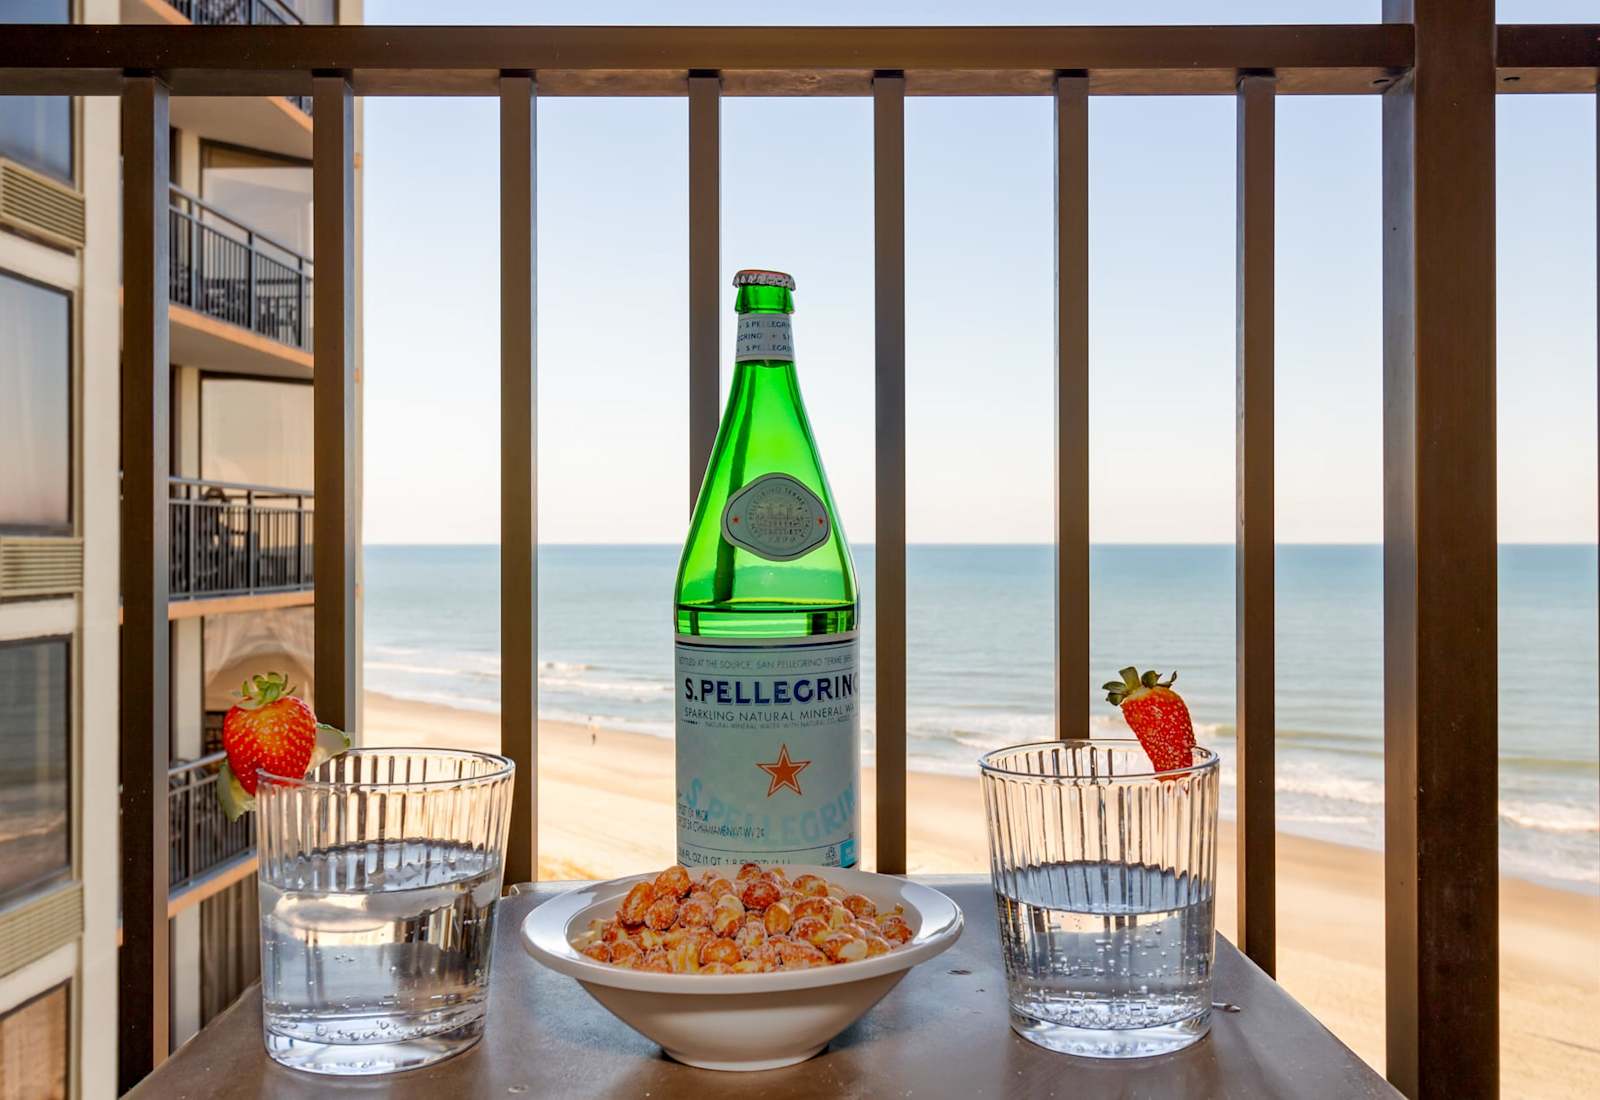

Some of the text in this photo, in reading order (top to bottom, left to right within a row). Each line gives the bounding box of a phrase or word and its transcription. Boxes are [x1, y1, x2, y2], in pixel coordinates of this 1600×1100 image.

[705, 660, 716, 668] THE
[756, 661, 774, 670] SAN
[776, 658, 823, 670] PELLEGRINO
[684, 707, 735, 722] SPARKLING
[739, 711, 794, 722] NATURAL
[800, 705, 843, 720] MINERAL
